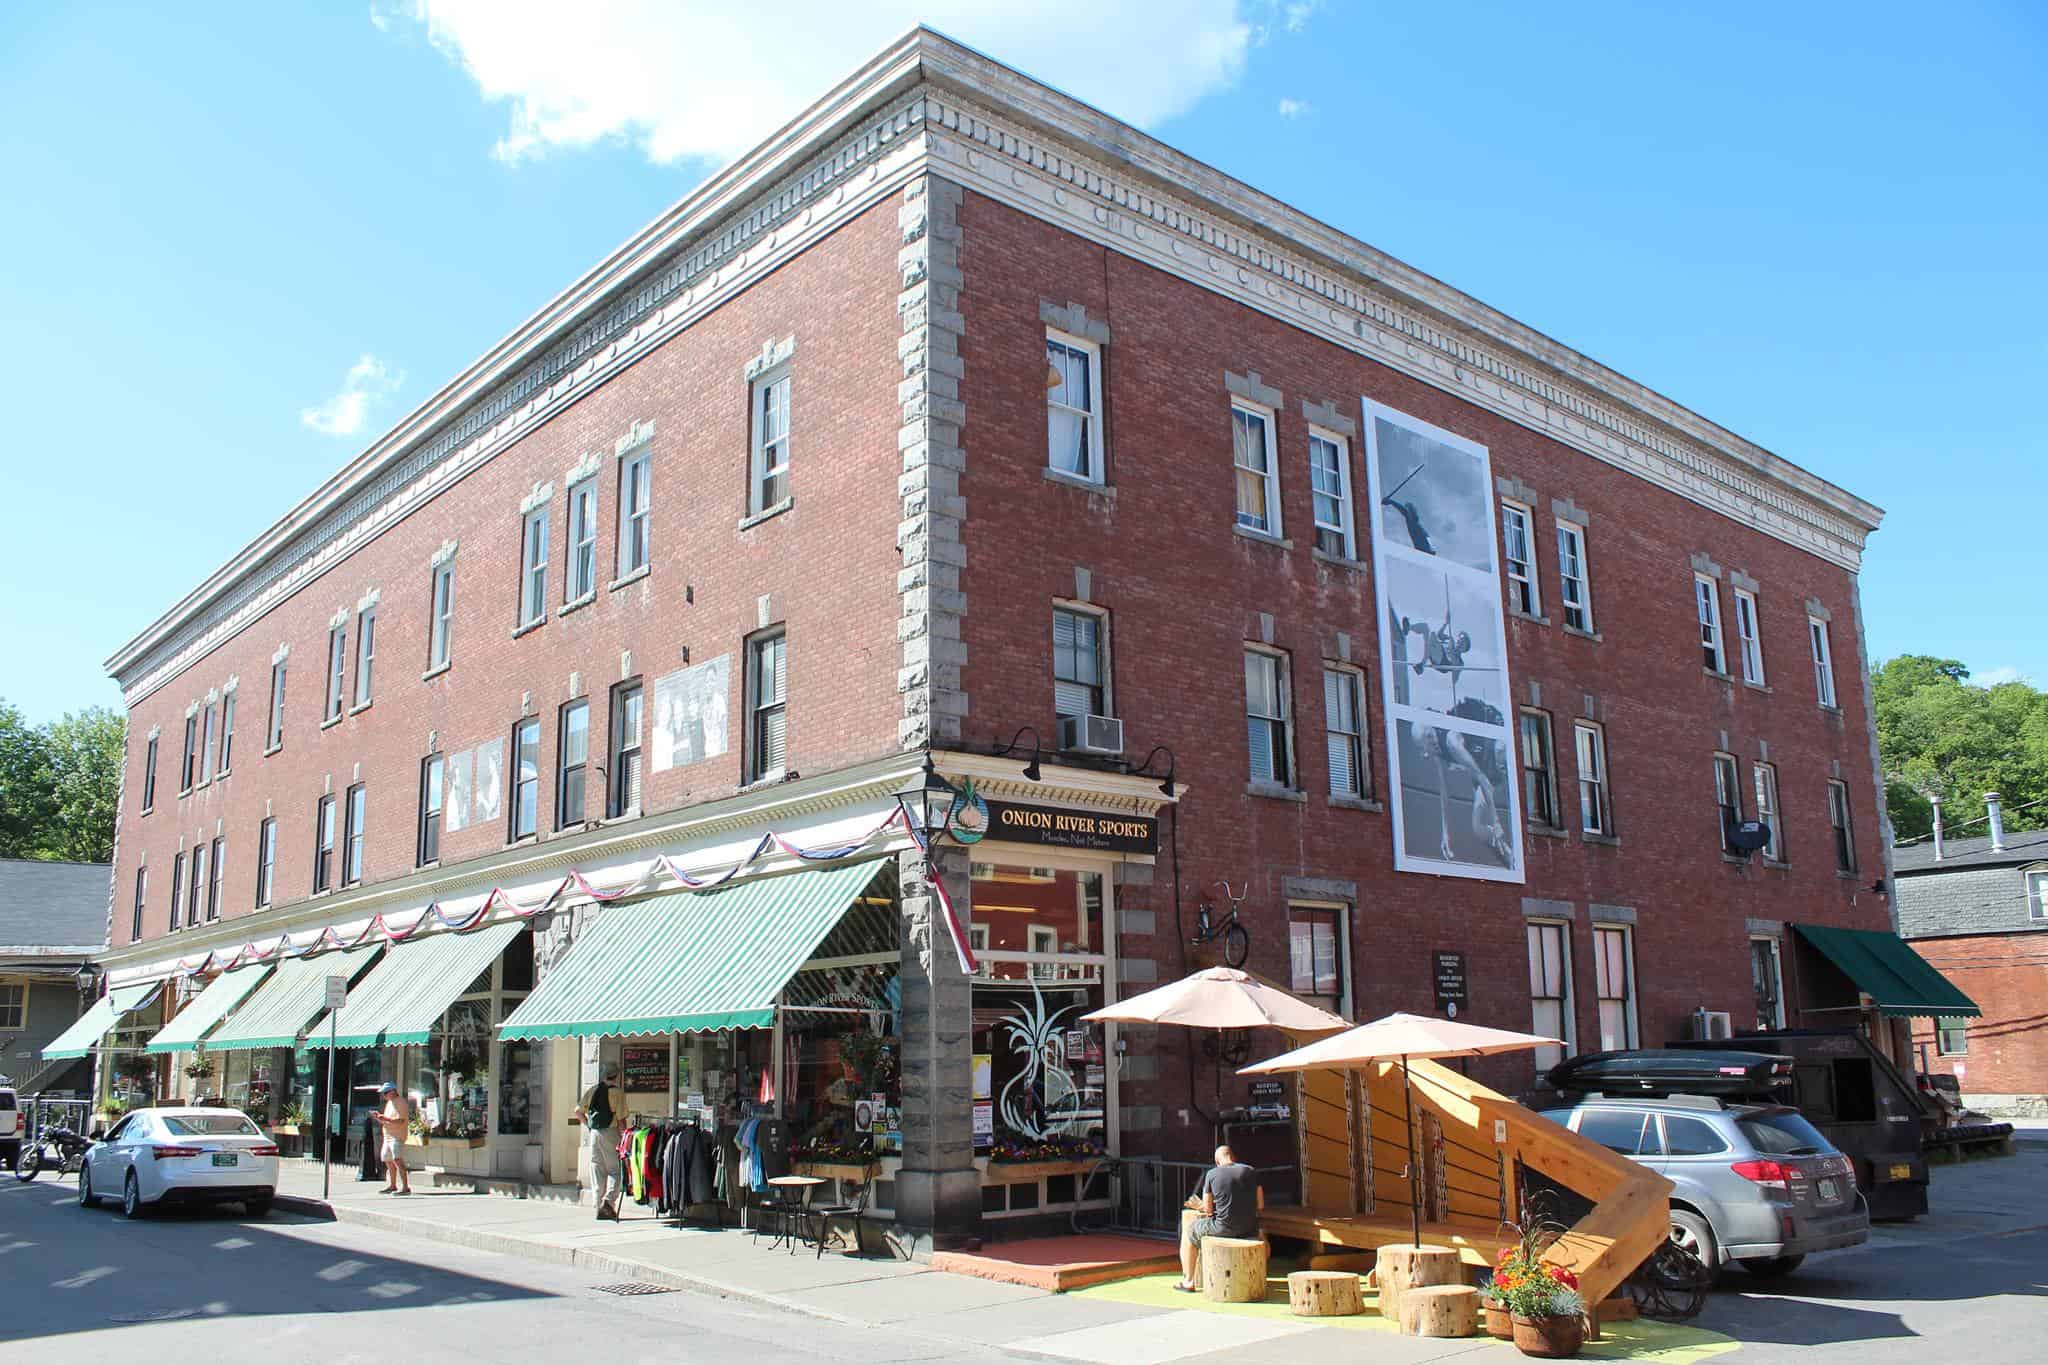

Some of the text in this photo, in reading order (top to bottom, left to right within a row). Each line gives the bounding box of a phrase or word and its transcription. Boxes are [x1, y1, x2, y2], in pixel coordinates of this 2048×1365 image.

[1001, 809, 1148, 838] ONION RIVER SPORTS
